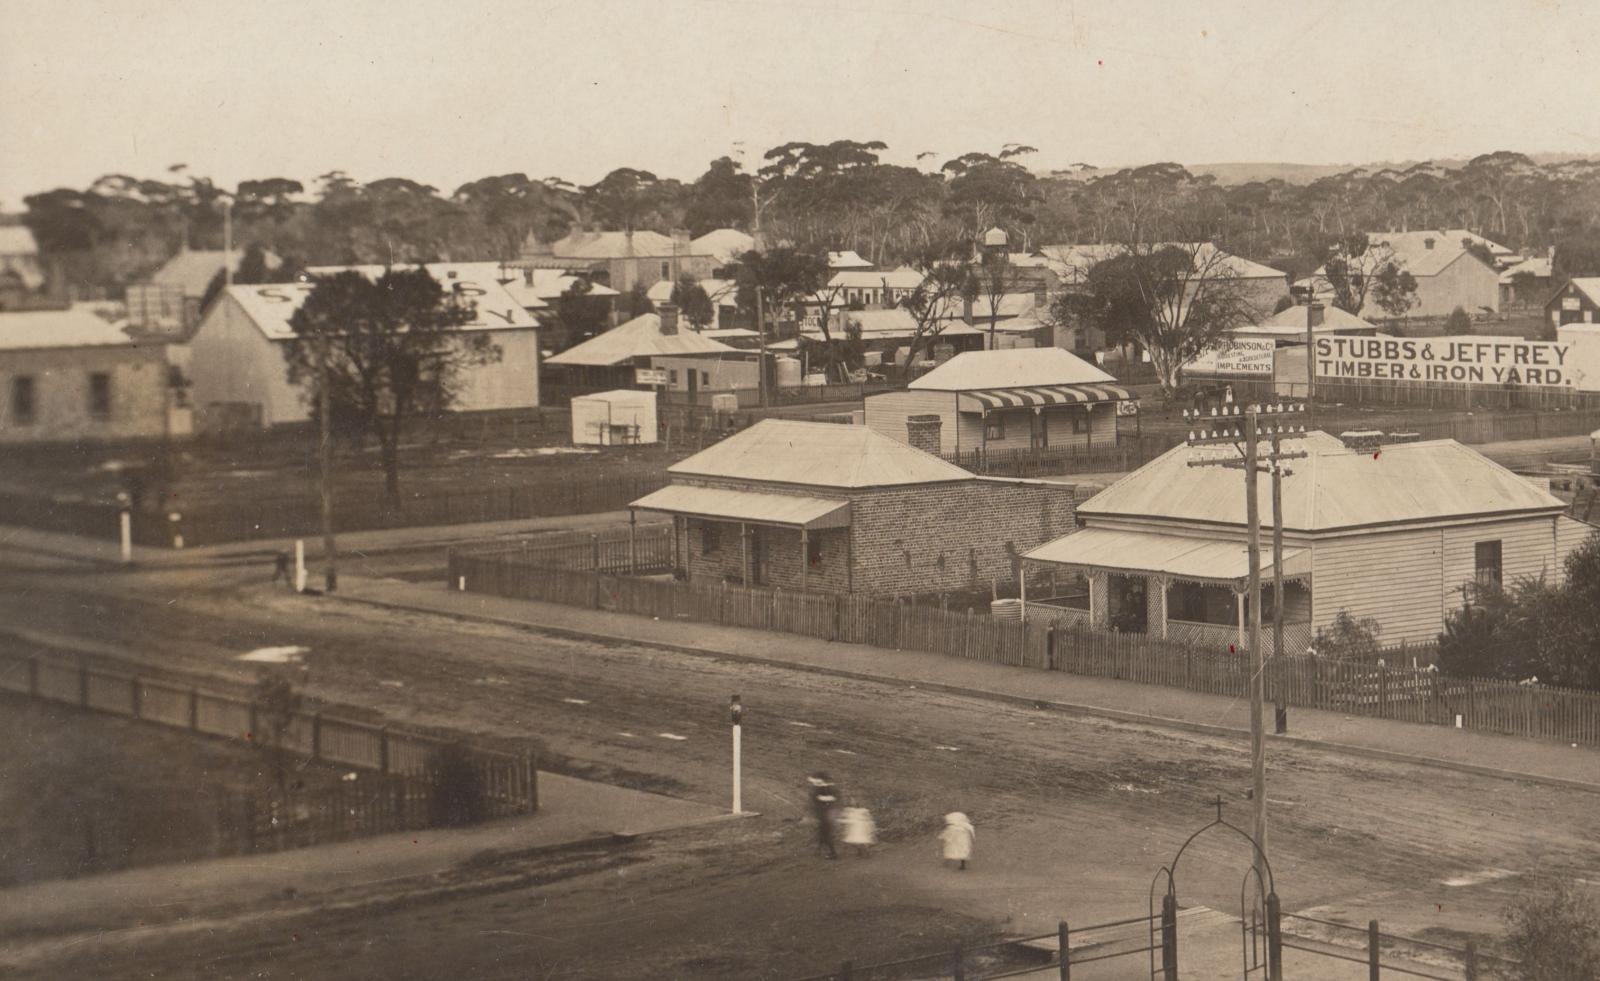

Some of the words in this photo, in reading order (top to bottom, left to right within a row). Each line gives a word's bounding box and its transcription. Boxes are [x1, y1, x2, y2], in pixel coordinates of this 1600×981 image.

[1317, 338, 1417, 360] STUBBS
[1421, 343, 1435, 361] &
[1441, 342, 1568, 365] JEFFREY
[1217, 362, 1271, 371] IMPLEMENTS
[1318, 360, 1405, 378] TIMBER
[1409, 364, 1421, 379] &
[1426, 364, 1484, 381] IRON
[1491, 366, 1570, 384] YARD.
